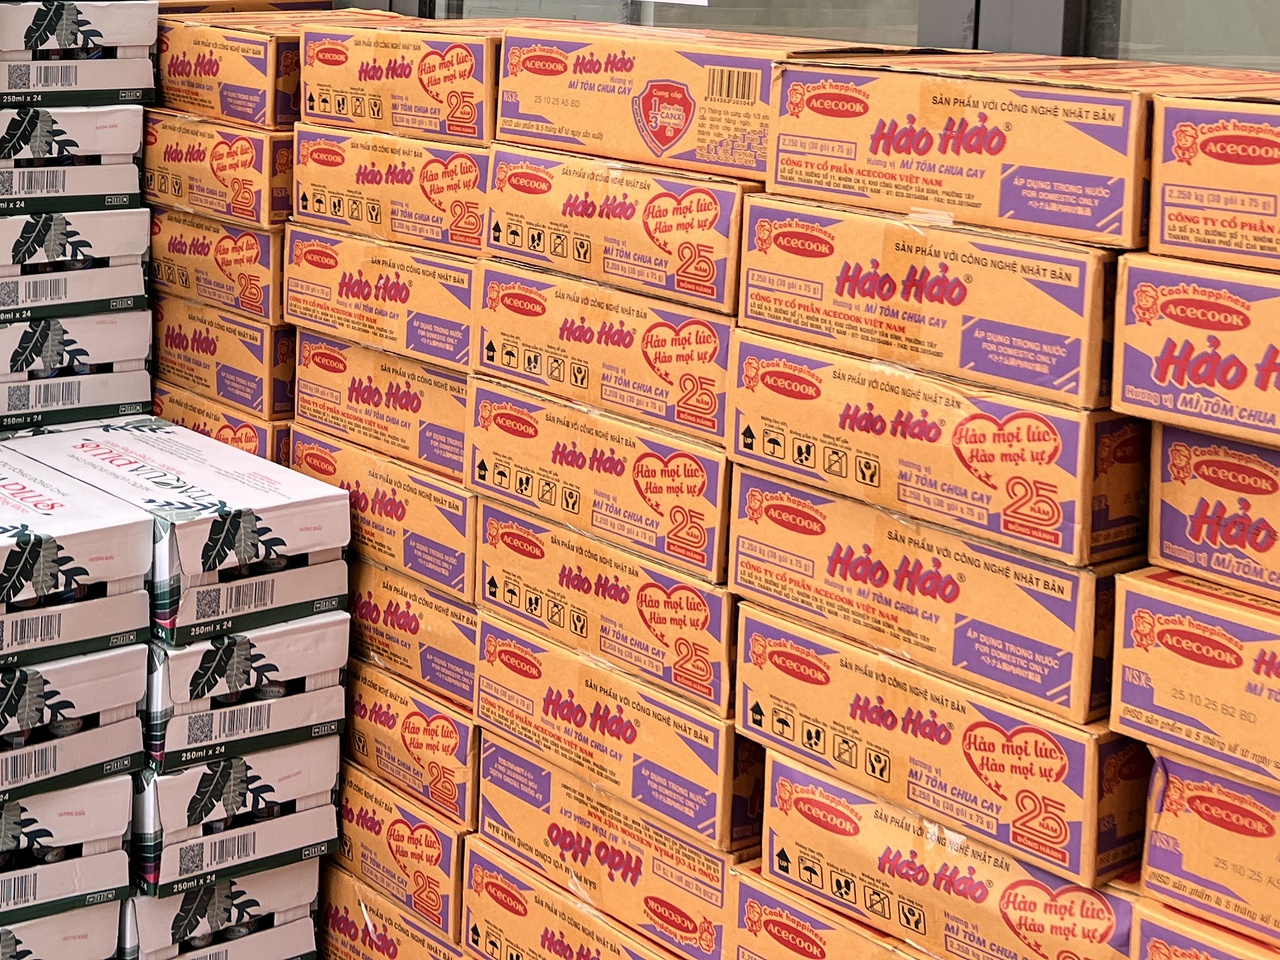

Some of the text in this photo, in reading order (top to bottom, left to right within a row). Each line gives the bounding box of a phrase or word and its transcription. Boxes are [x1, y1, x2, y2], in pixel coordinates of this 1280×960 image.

[168, 49, 220, 78] Hảo Hảo
[358, 55, 413, 82] Hảo Hảo
[573, 50, 634, 75] Hảo Hảo
[534, 95, 542, 103] 25
[543, 96, 550, 104] 10
[551, 97, 560, 105] 25
[568, 80, 632, 96] MÌ TÔM CHUA CAY
[806, 81, 870, 99] Cook happiness
[931, 94, 1116, 122] SẢN PHẨM VỚI CÔNG NGHỆ NHẬT BẢN
[869, 111, 1007, 156] Hảo Hảo
[780, 157, 802, 168] CÔNG
[804, 161, 815, 169] TY
[817, 159, 829, 171] CỔ
[830, 163, 854, 175] PHẦN
[856, 168, 897, 181] ACECOOK
[899, 173, 920, 185] VIỆT
[922, 177, 942, 187] NAM
[900, 159, 913, 170] MÌ
[915, 160, 936, 173] TÔM
[938, 164, 963, 177] CHUA
[966, 167, 985, 179] CAY
[16, 200, 24, 208] 24
[562, 191, 637, 221] Hảo Hảo
[337, 269, 410, 304] Hảo Hảo
[836, 258, 967, 307] Hảo Hảo
[1160, 284, 1251, 311] Cook happiness
[760, 360, 823, 384] Cook happiness
[1154, 335, 1248, 391] Hảo
[839, 402, 886, 436] Hảo
[890, 409, 942, 443] Hảo
[1180, 394, 1276, 425] MÌ TÔM CHUA
[954, 426, 987, 446] Hào
[992, 428, 1021, 448] mọi
[968, 447, 1047, 466] Hào mọi sự
[1003, 476, 1063, 528] 25
[190, 624, 214, 636] 250ml
[222, 620, 232, 629] 24
[1171, 688, 1185, 701] 25
[1189, 692, 1202, 706] 10
[1204, 697, 1219, 712] 25
[542, 686, 637, 745] Hảo Hảo
[850, 693, 952, 746] Hảo Hảo
[547, 823, 644, 887] Hảo Hảo
[878, 846, 989, 905] Hảo Hảo
